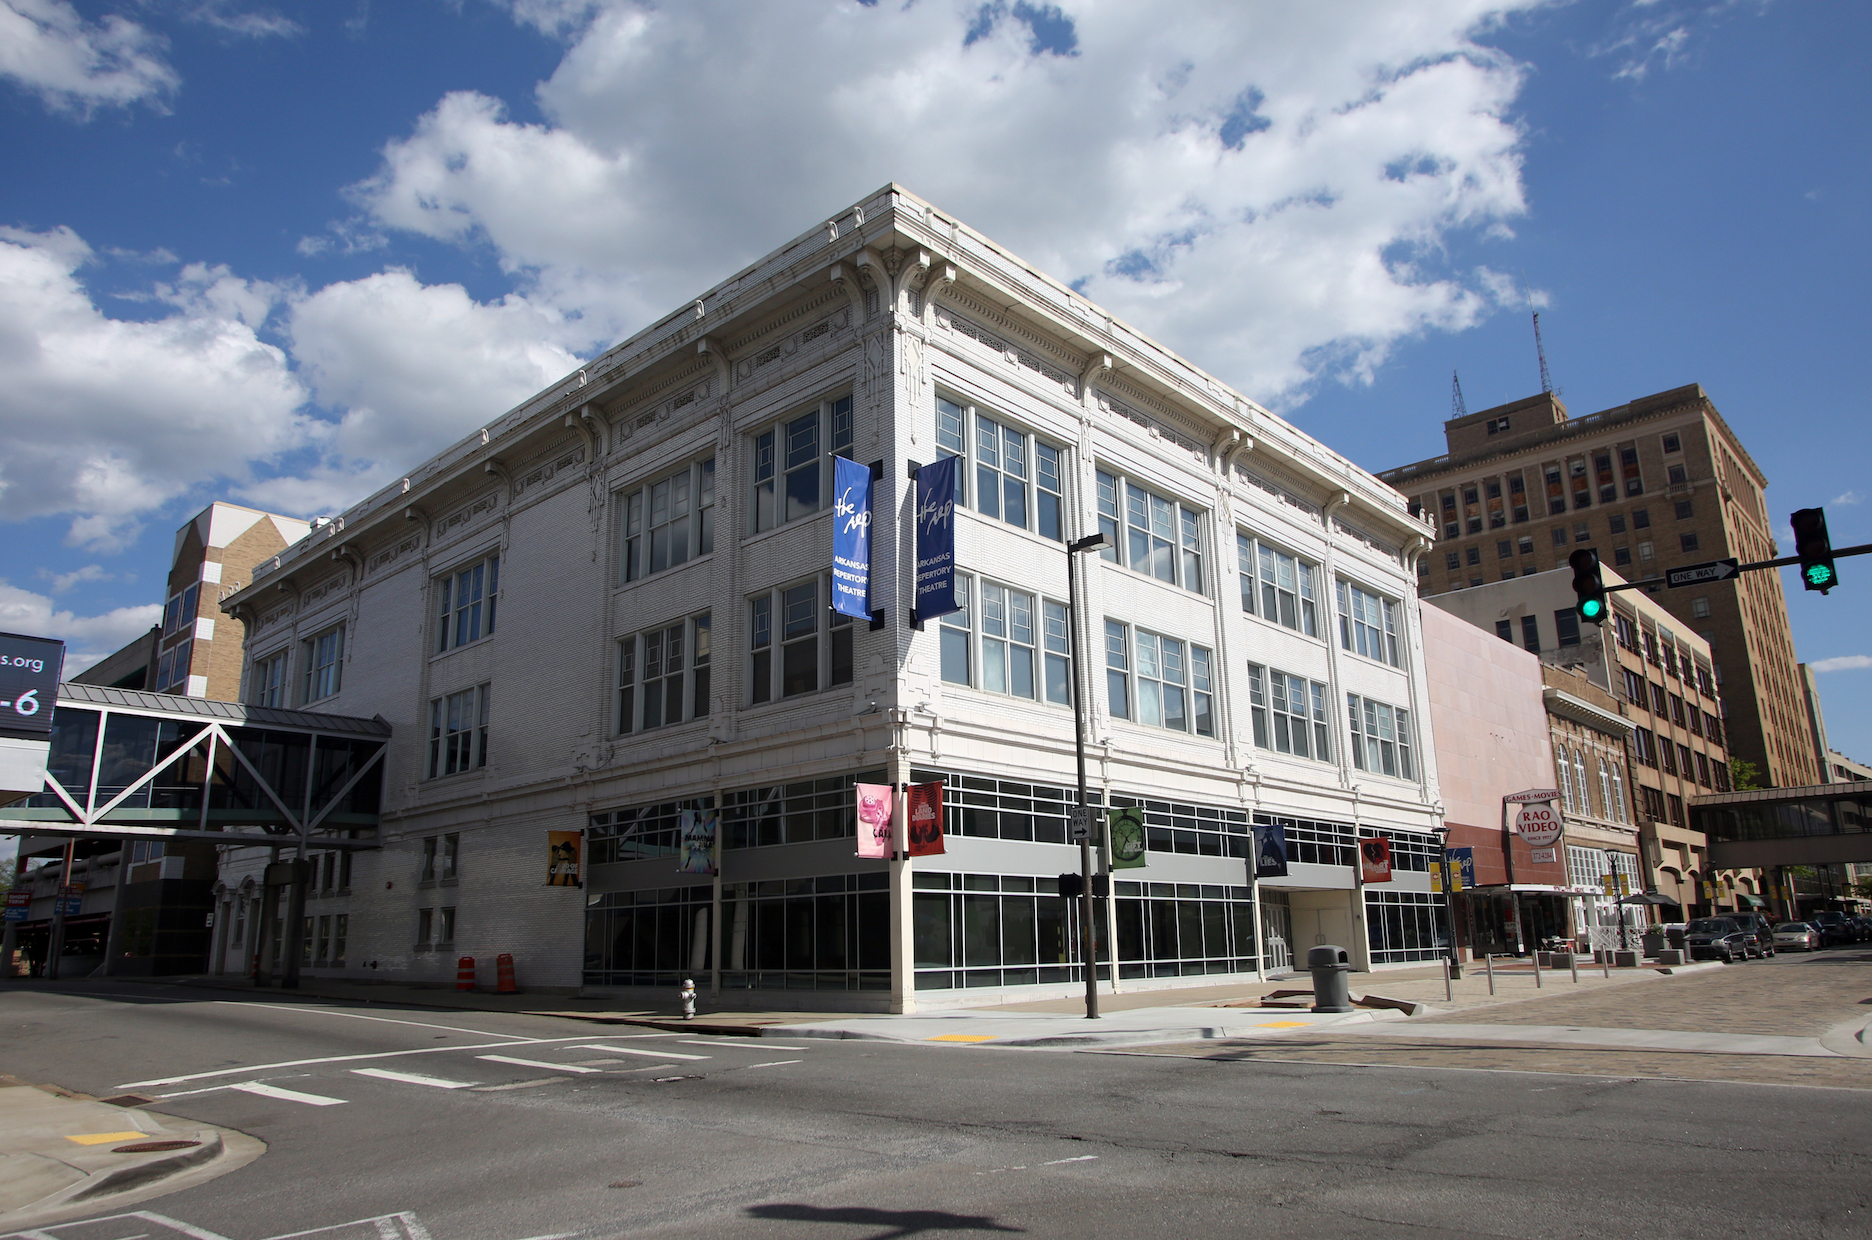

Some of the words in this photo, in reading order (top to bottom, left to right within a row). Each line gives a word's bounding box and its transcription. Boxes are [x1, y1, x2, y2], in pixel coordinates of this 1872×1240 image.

[835, 555, 869, 571] ARKANSAS
[1673, 571, 1693, 582] ONE
[1695, 567, 1716, 578] WAY
[837, 583, 866, 598] THEATRE
[919, 580, 948, 595] THEATRE
[1072, 808, 1087, 818] ONE
[1523, 810, 1551, 822] RAO
[1072, 818, 1088, 827] WAY
[1518, 820, 1558, 833] VIDEO
